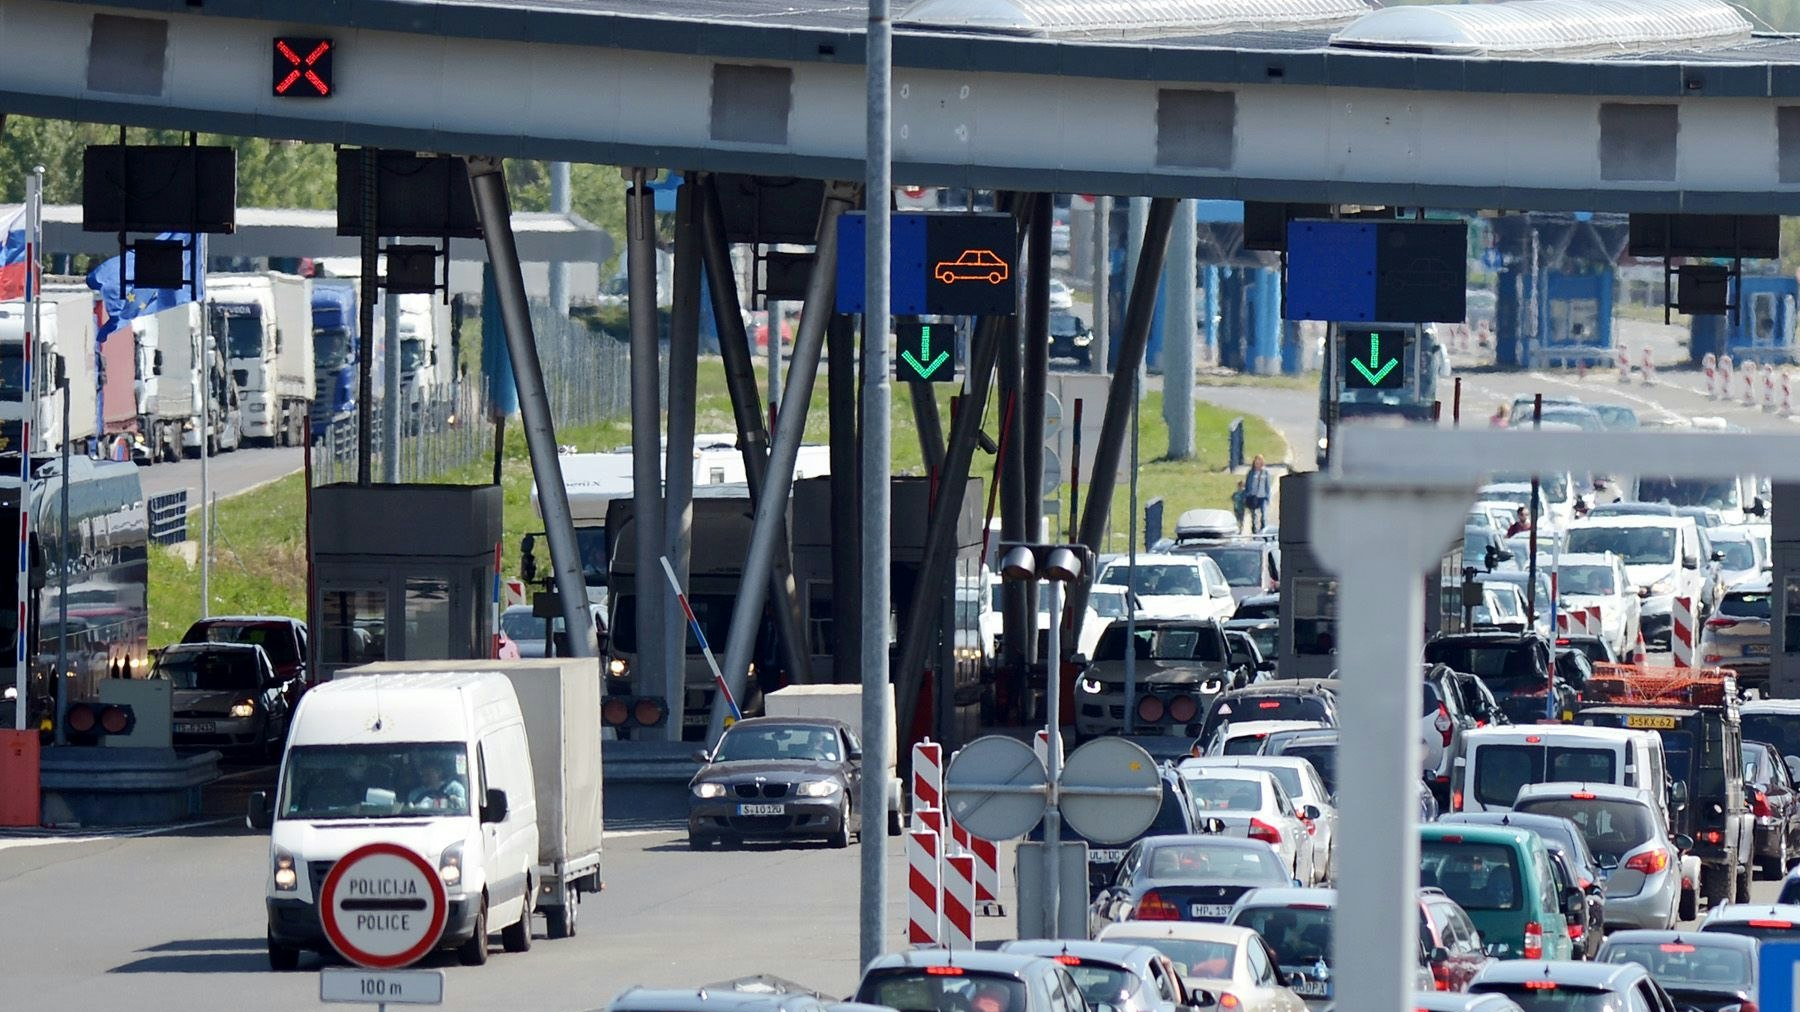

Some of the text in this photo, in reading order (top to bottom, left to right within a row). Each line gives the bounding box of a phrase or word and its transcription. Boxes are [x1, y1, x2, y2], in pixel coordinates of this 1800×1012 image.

[350, 879, 417, 895] POLICIJA
[357, 914, 410, 931] POLICE
[361, 979, 402, 995] 100 m
